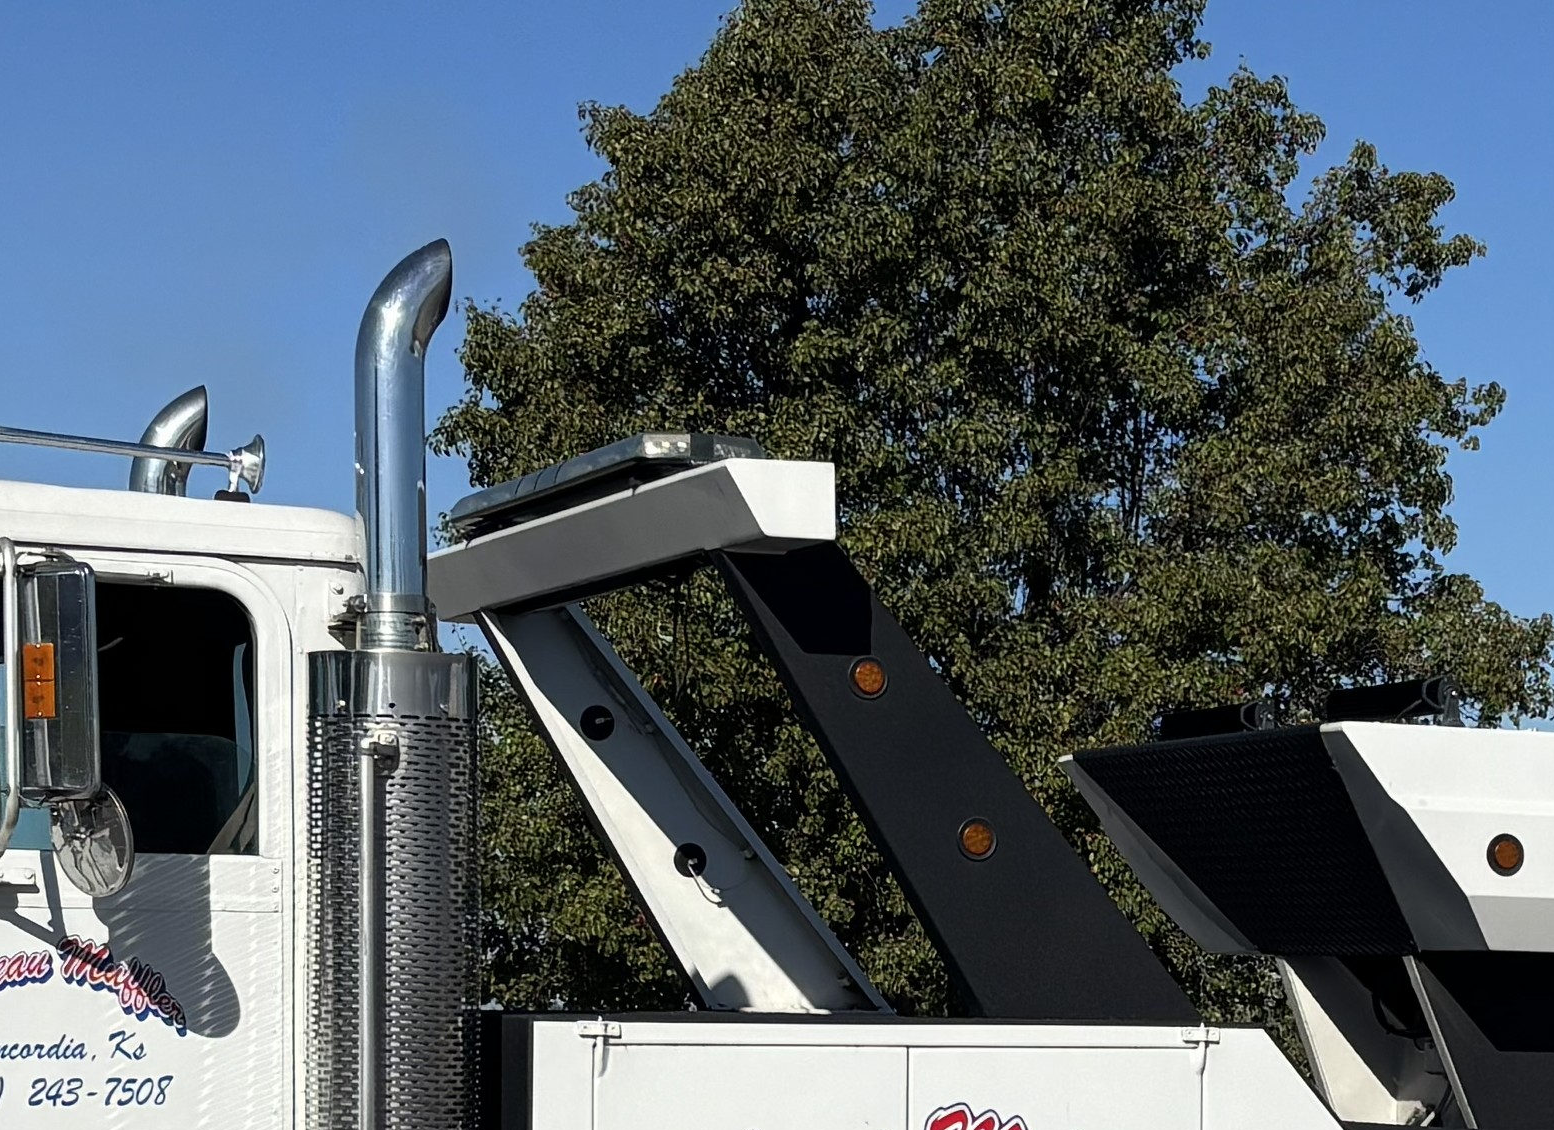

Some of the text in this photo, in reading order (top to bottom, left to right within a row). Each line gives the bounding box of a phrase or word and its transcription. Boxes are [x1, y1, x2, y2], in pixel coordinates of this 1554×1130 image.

[57, 935, 188, 1037] Muffler
[107, 1030, 147, 1061] Ks
[27, 1074, 174, 1108] 243-7508
